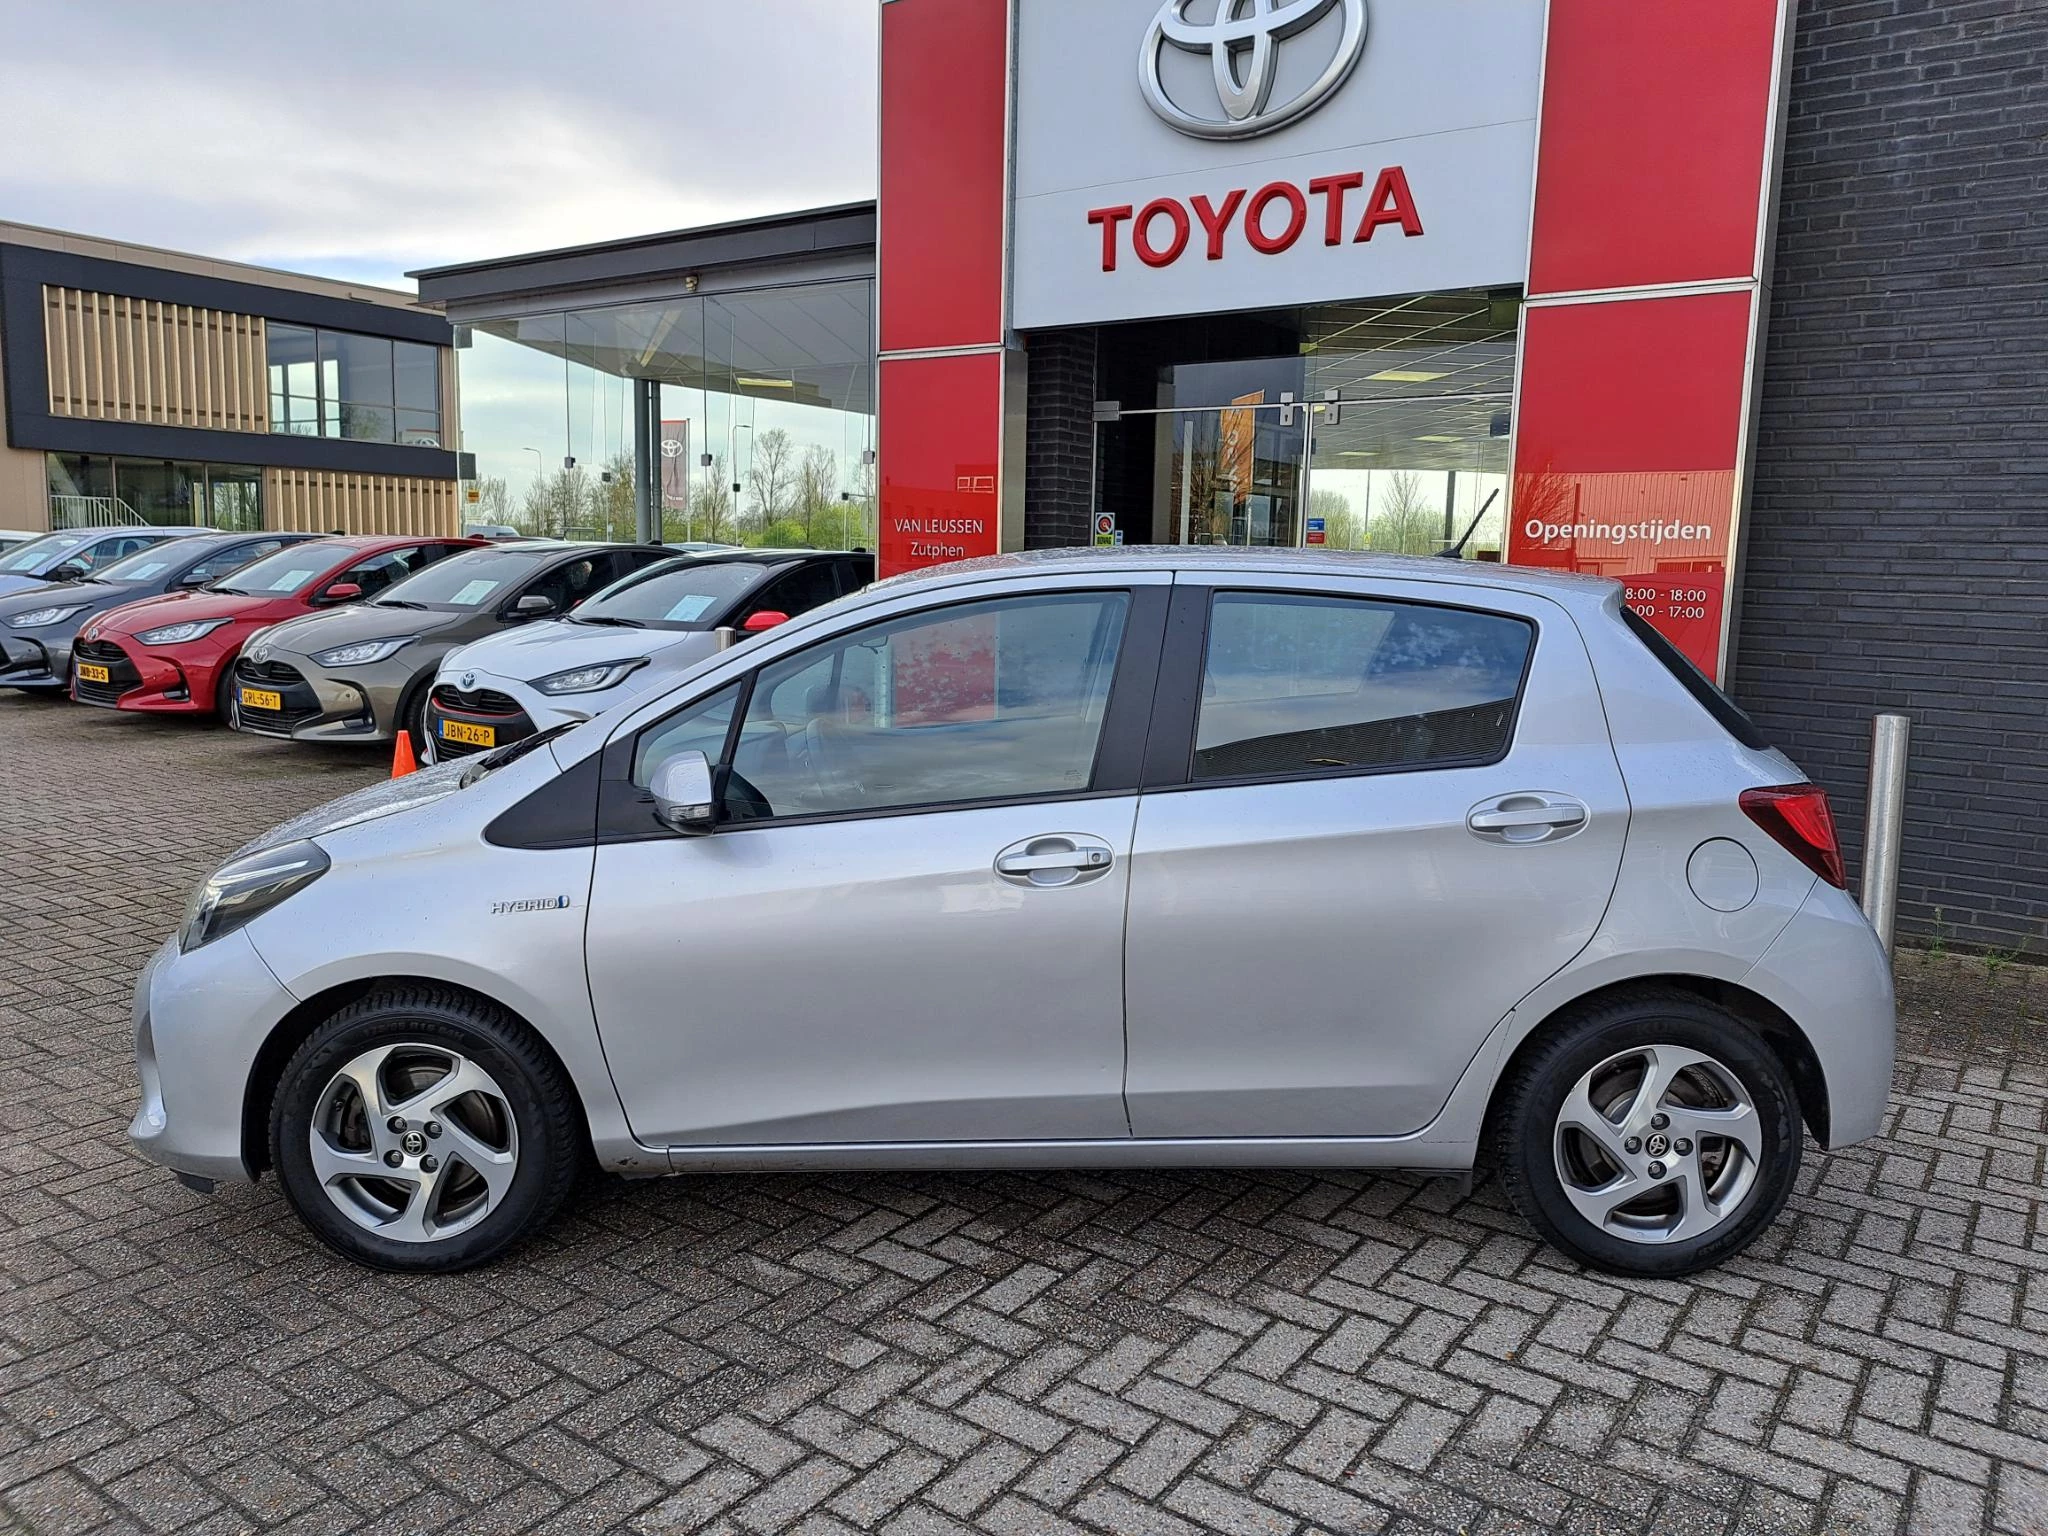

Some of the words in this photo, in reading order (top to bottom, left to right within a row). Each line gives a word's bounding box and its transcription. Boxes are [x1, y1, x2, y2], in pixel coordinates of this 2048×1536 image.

[1087, 165, 1424, 271] TOYOTA
[894, 518, 921, 533] VAN
[924, 519, 983, 534] LEUSSEN
[1524, 519, 1712, 545] Openingstijden
[910, 541, 964, 559] Zutphen
[1669, 589, 1707, 602] 18:00
[1626, 604, 1655, 617] :00
[1668, 606, 1705, 619] 17:00
[243, 690, 277, 708] GRL-56-T
[445, 723, 490, 743] JBN-26-P
[491, 897, 558, 914] HYBRID
